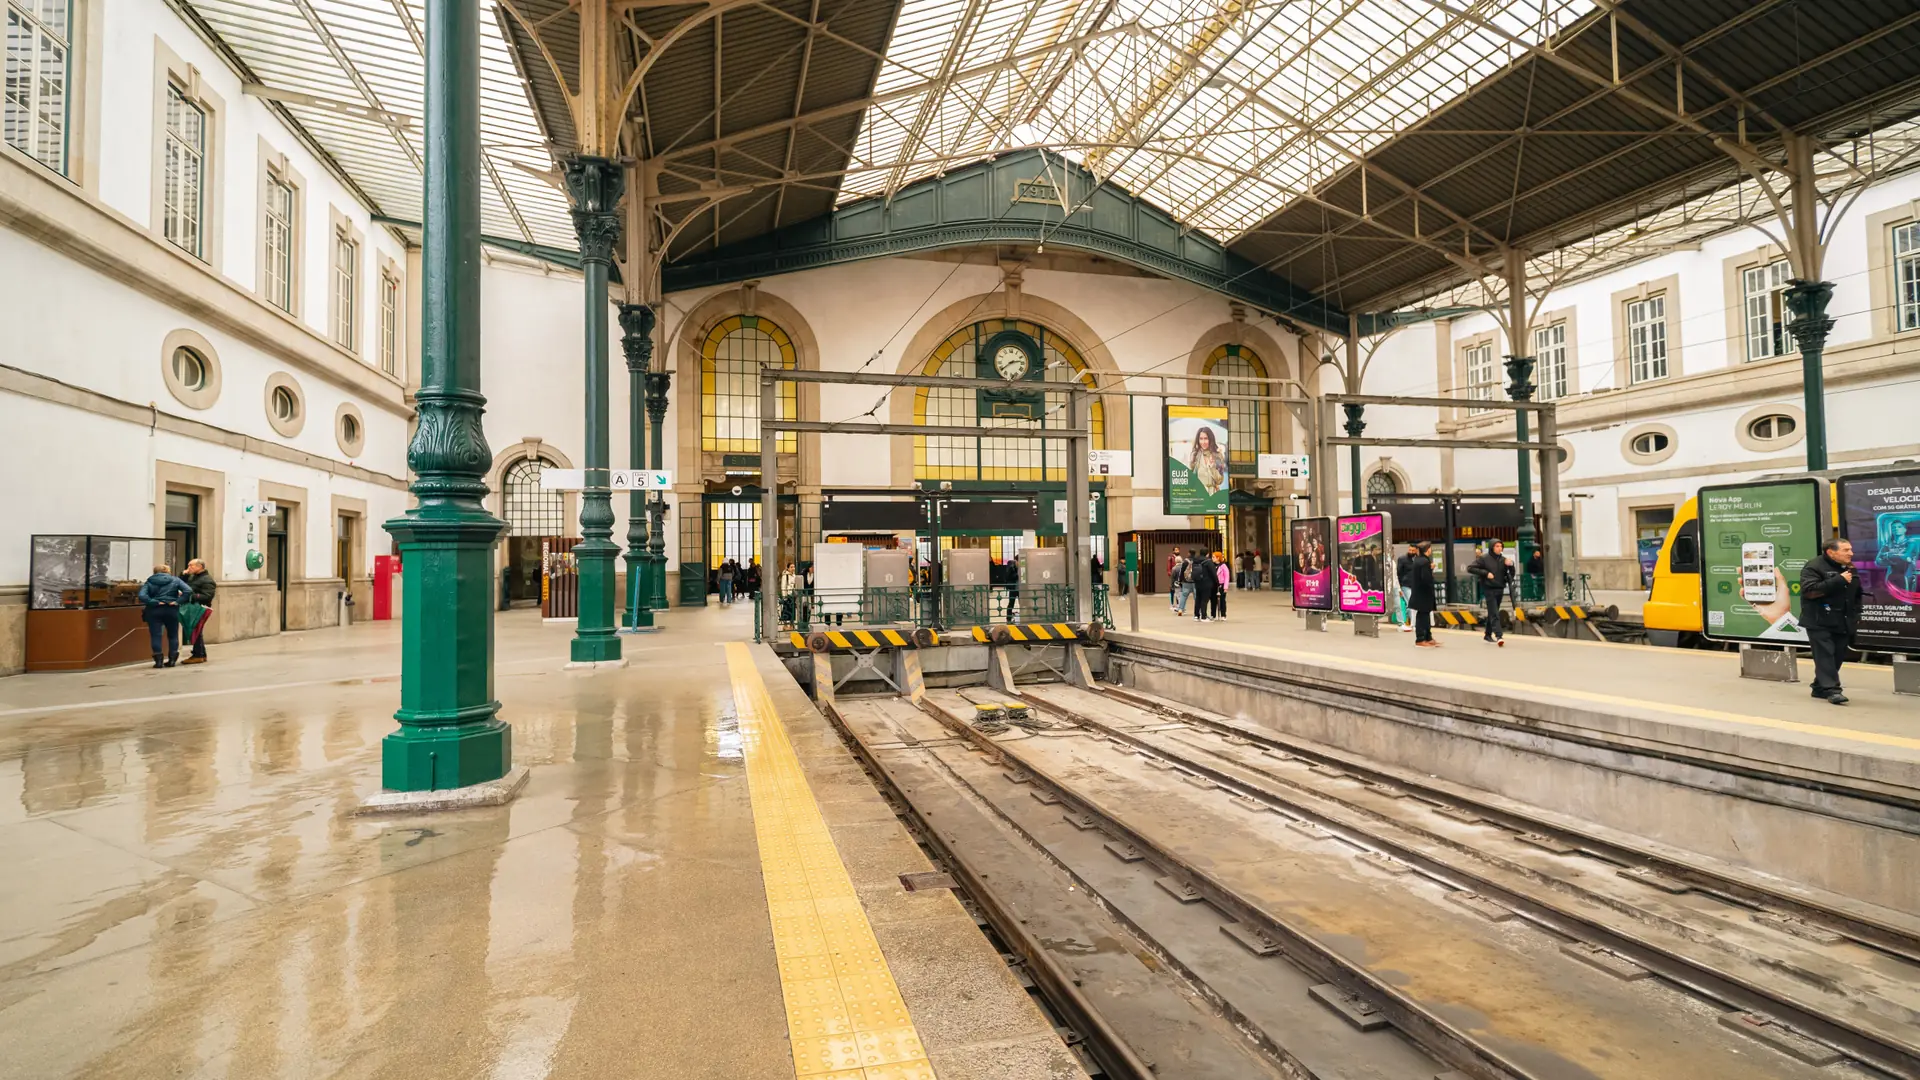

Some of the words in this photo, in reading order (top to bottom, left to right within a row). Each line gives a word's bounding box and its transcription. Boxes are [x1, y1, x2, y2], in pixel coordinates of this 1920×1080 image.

[1023, 185, 1057, 199] 1910
[615, 475, 625, 485] A
[638, 477, 645, 487] 5
